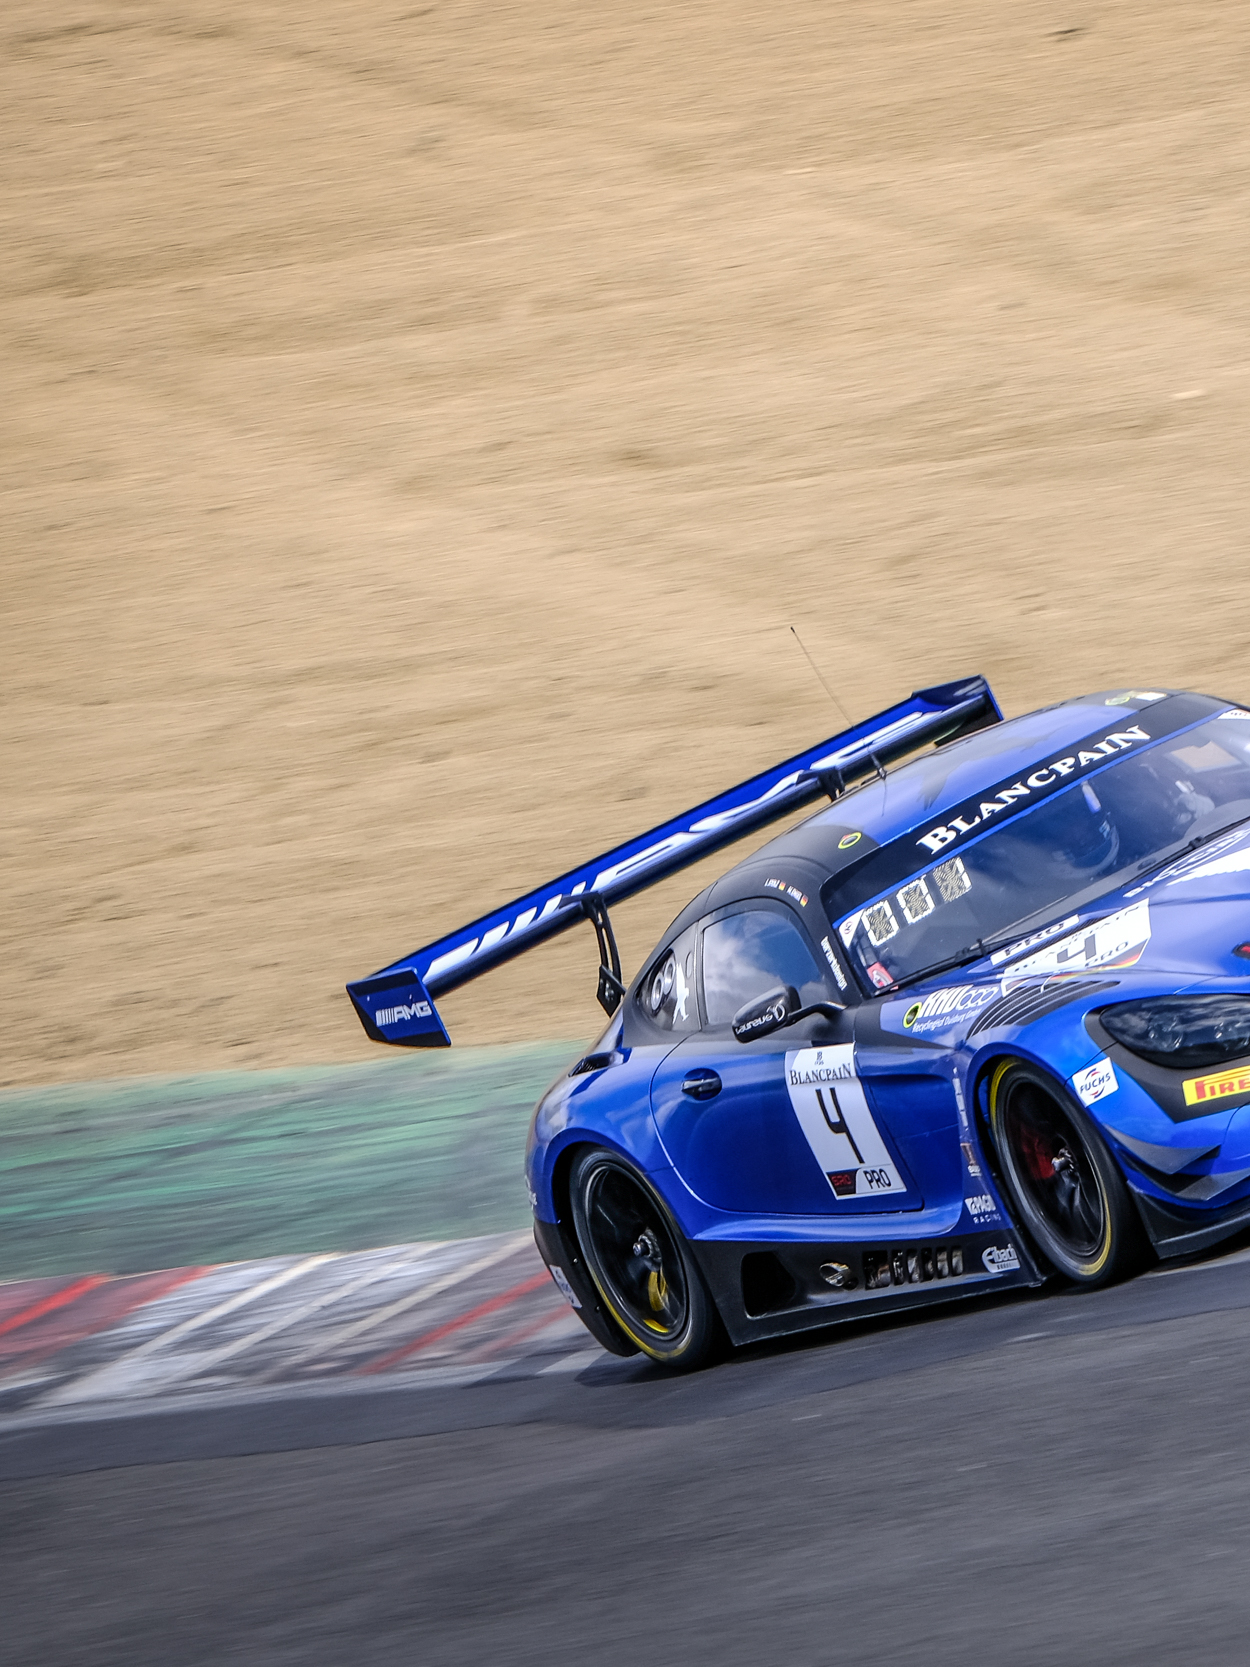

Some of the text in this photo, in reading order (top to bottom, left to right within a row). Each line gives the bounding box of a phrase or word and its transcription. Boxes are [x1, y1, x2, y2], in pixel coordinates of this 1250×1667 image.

[916, 725, 1151, 854] BLANCPAIN
[1004, 921, 1066, 957] PRO
[1056, 933, 1097, 964] 4
[393, 1001, 432, 1023] AMG
[789, 1062, 853, 1086] BLANCPAIN
[1079, 1073, 1112, 1095] FUCHS
[815, 1087, 866, 1165] 4
[863, 1168, 892, 1190] PRO
